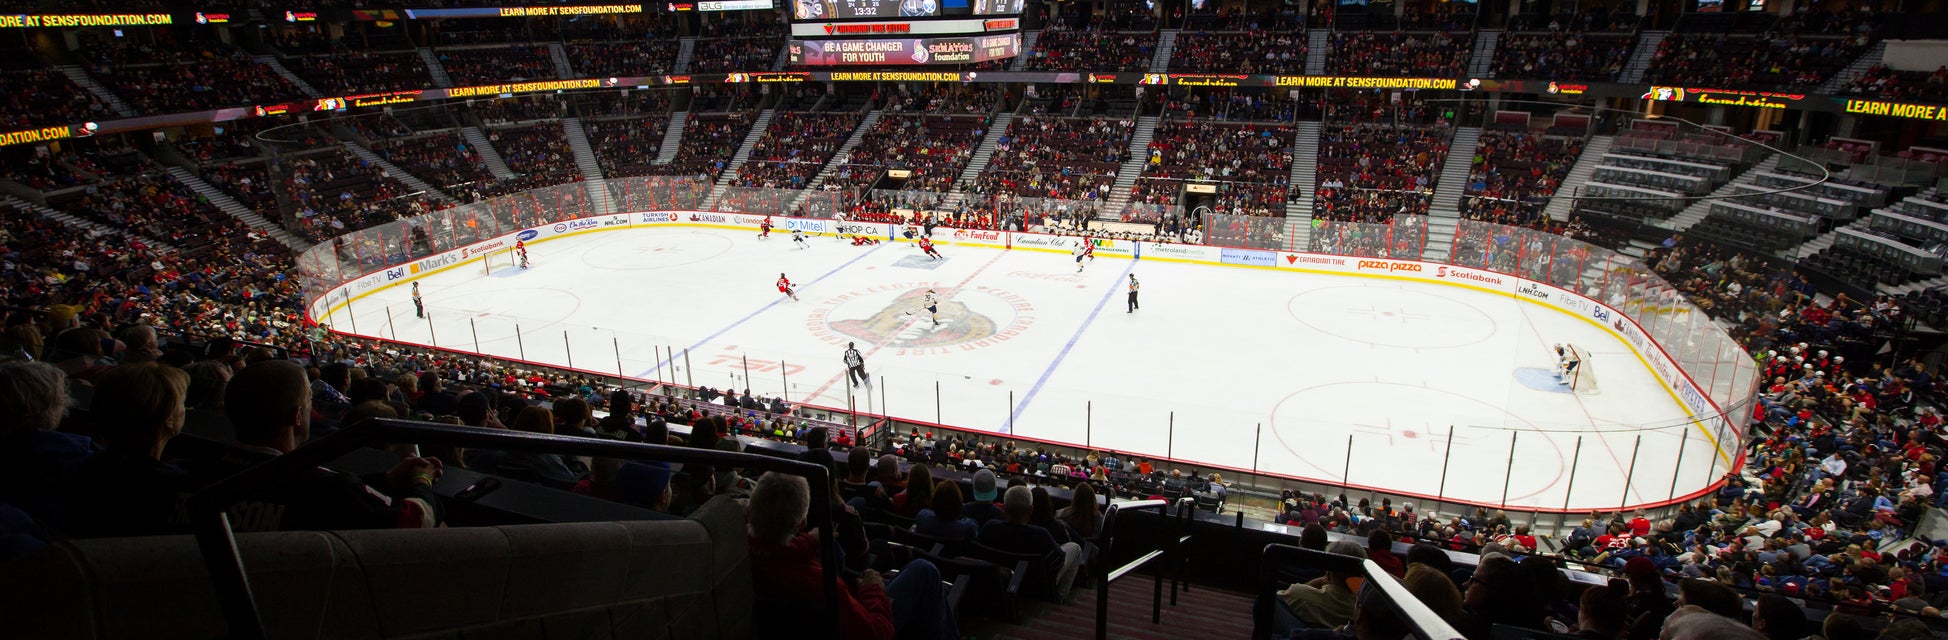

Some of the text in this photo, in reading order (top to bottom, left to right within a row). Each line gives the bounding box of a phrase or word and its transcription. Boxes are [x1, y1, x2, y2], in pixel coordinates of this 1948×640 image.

[500, 5, 642, 16] LEARN MORE AT SENSFOUNDATION.COM
[854, 7, 876, 15] 13:32
[26, 16, 40, 27] AT
[43, 14, 172, 27] SENSFOUNDATION.COM
[825, 42, 902, 52] BE A GAME CHANGER
[843, 52, 885, 62] FOR YOUTH
[934, 52, 970, 61] foundation
[831, 73, 960, 81] LEARN MORE AT SENSFOUNDATION.COM
[1276, 77, 1456, 89] LEARN MORE AT SENSFOUNDATION.COM
[450, 80, 600, 97] LEARN MORE AT SENSFOUNDATION.COM
[1846, 100, 1948, 120] LEARN MORE A
[699, 214, 725, 223] CANADIAN
[800, 220, 823, 232] Mitel
[470, 240, 504, 254] Scotiabank
[1016, 235, 1047, 246] Canadian
[1048, 236, 1066, 247] Club
[419, 253, 457, 272] Mark's
[1300, 256, 1330, 264] CANADIAN
[1358, 260, 1422, 272] pizza pizza
[386, 267, 404, 280] Bell
[1450, 270, 1502, 285] Scotiabank
[357, 276, 382, 290] Fibe TV
[1518, 287, 1549, 299] LNH.COM
[1560, 294, 1589, 311] Fibe TV
[1594, 305, 1610, 323] Bell
